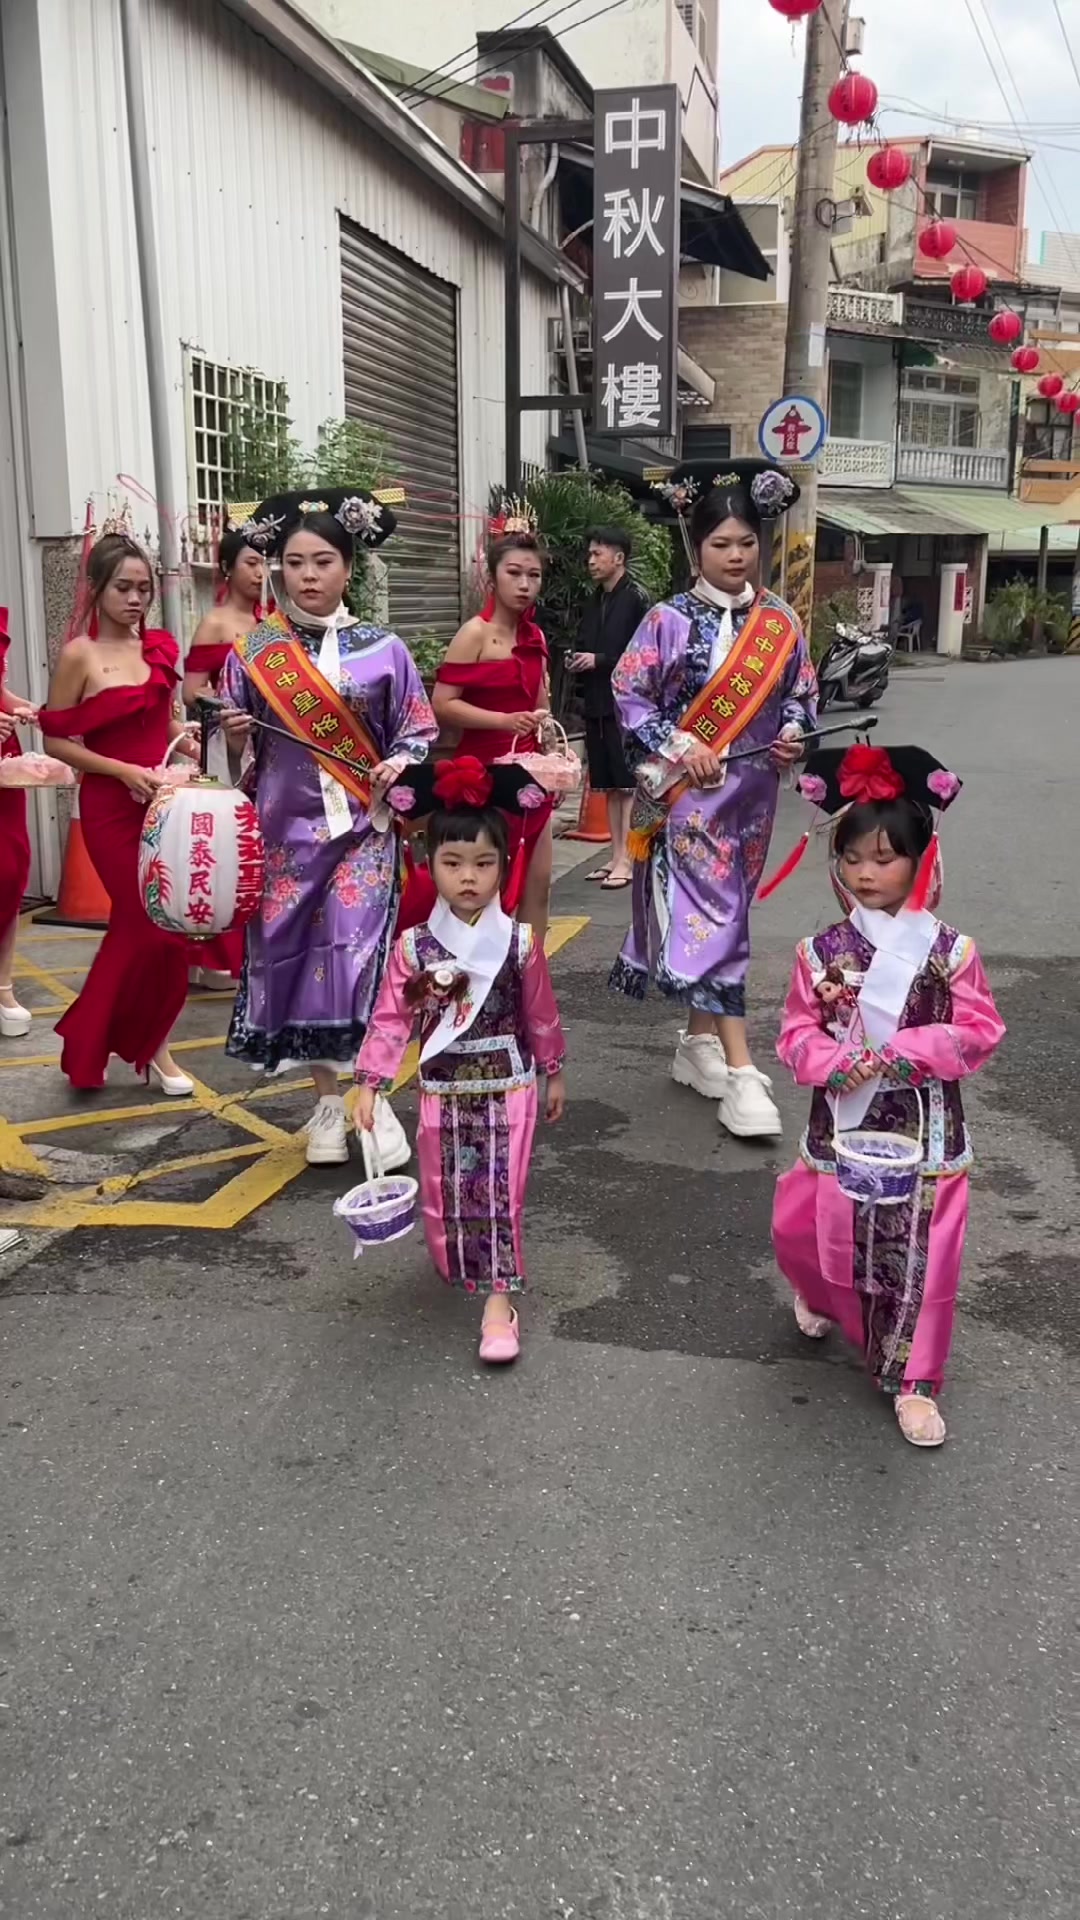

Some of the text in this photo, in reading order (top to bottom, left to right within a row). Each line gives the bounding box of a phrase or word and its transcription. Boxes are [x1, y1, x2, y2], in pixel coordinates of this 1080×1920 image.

[601, 97, 666, 429] 中秋大樓
[692, 618, 784, 743] 台中皇格格迎
[184, 811, 217, 925] 國泰民安
